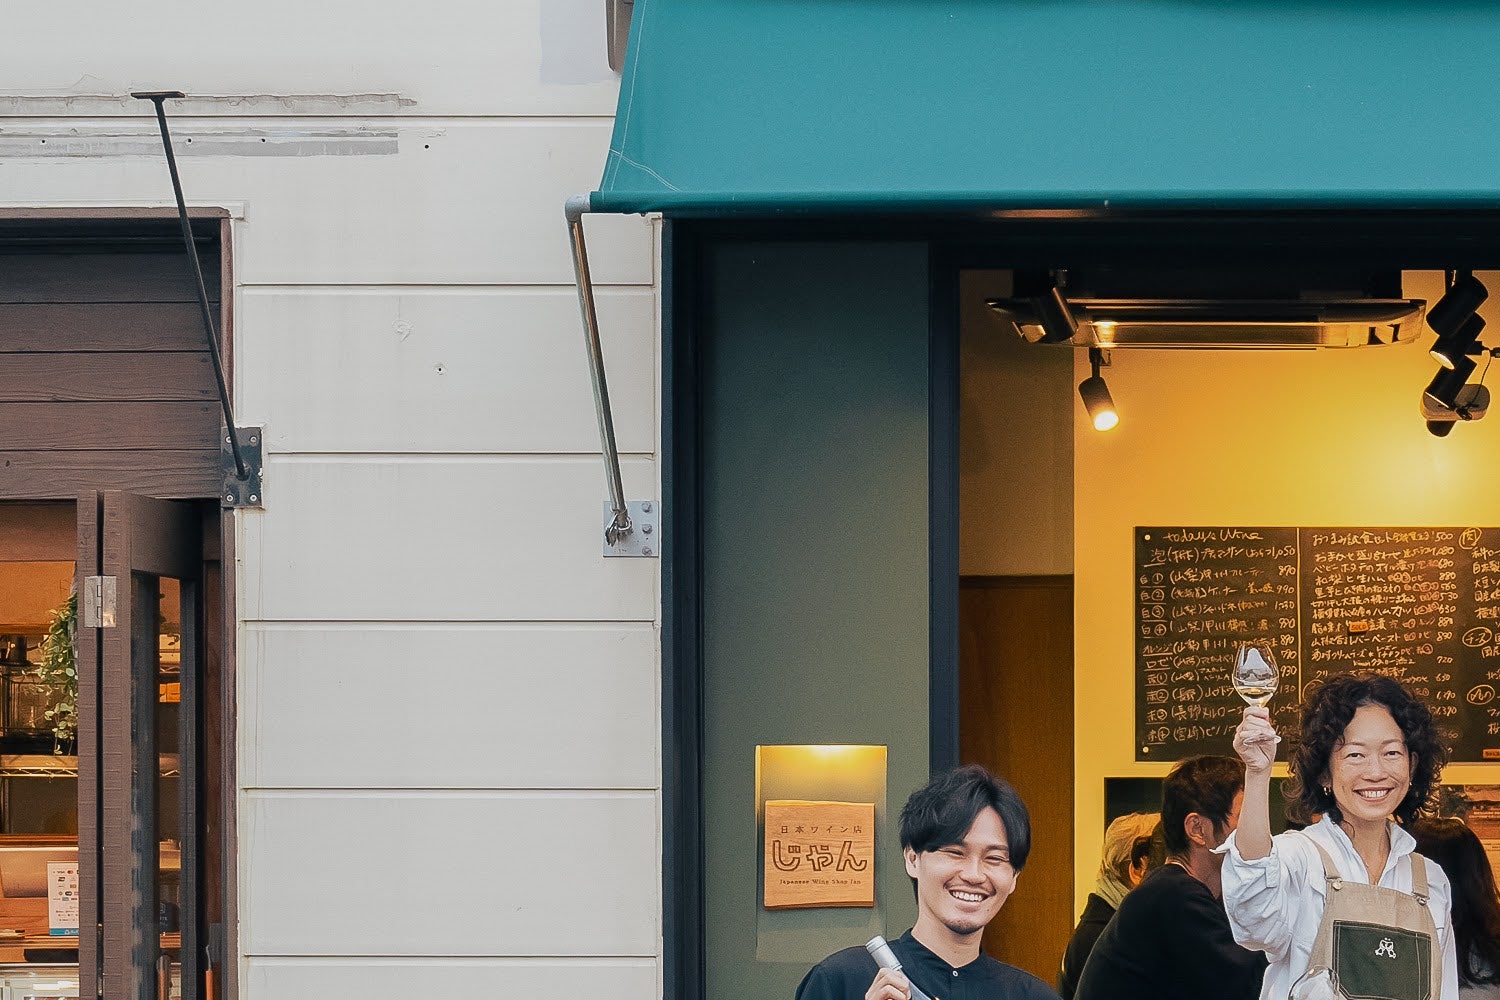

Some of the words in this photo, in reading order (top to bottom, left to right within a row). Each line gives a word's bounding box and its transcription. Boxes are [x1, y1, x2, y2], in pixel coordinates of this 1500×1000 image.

[1276, 585, 1295, 594] 990
[781, 825, 862, 834] 日本ワイン店
[772, 839, 868, 872] じゃん
